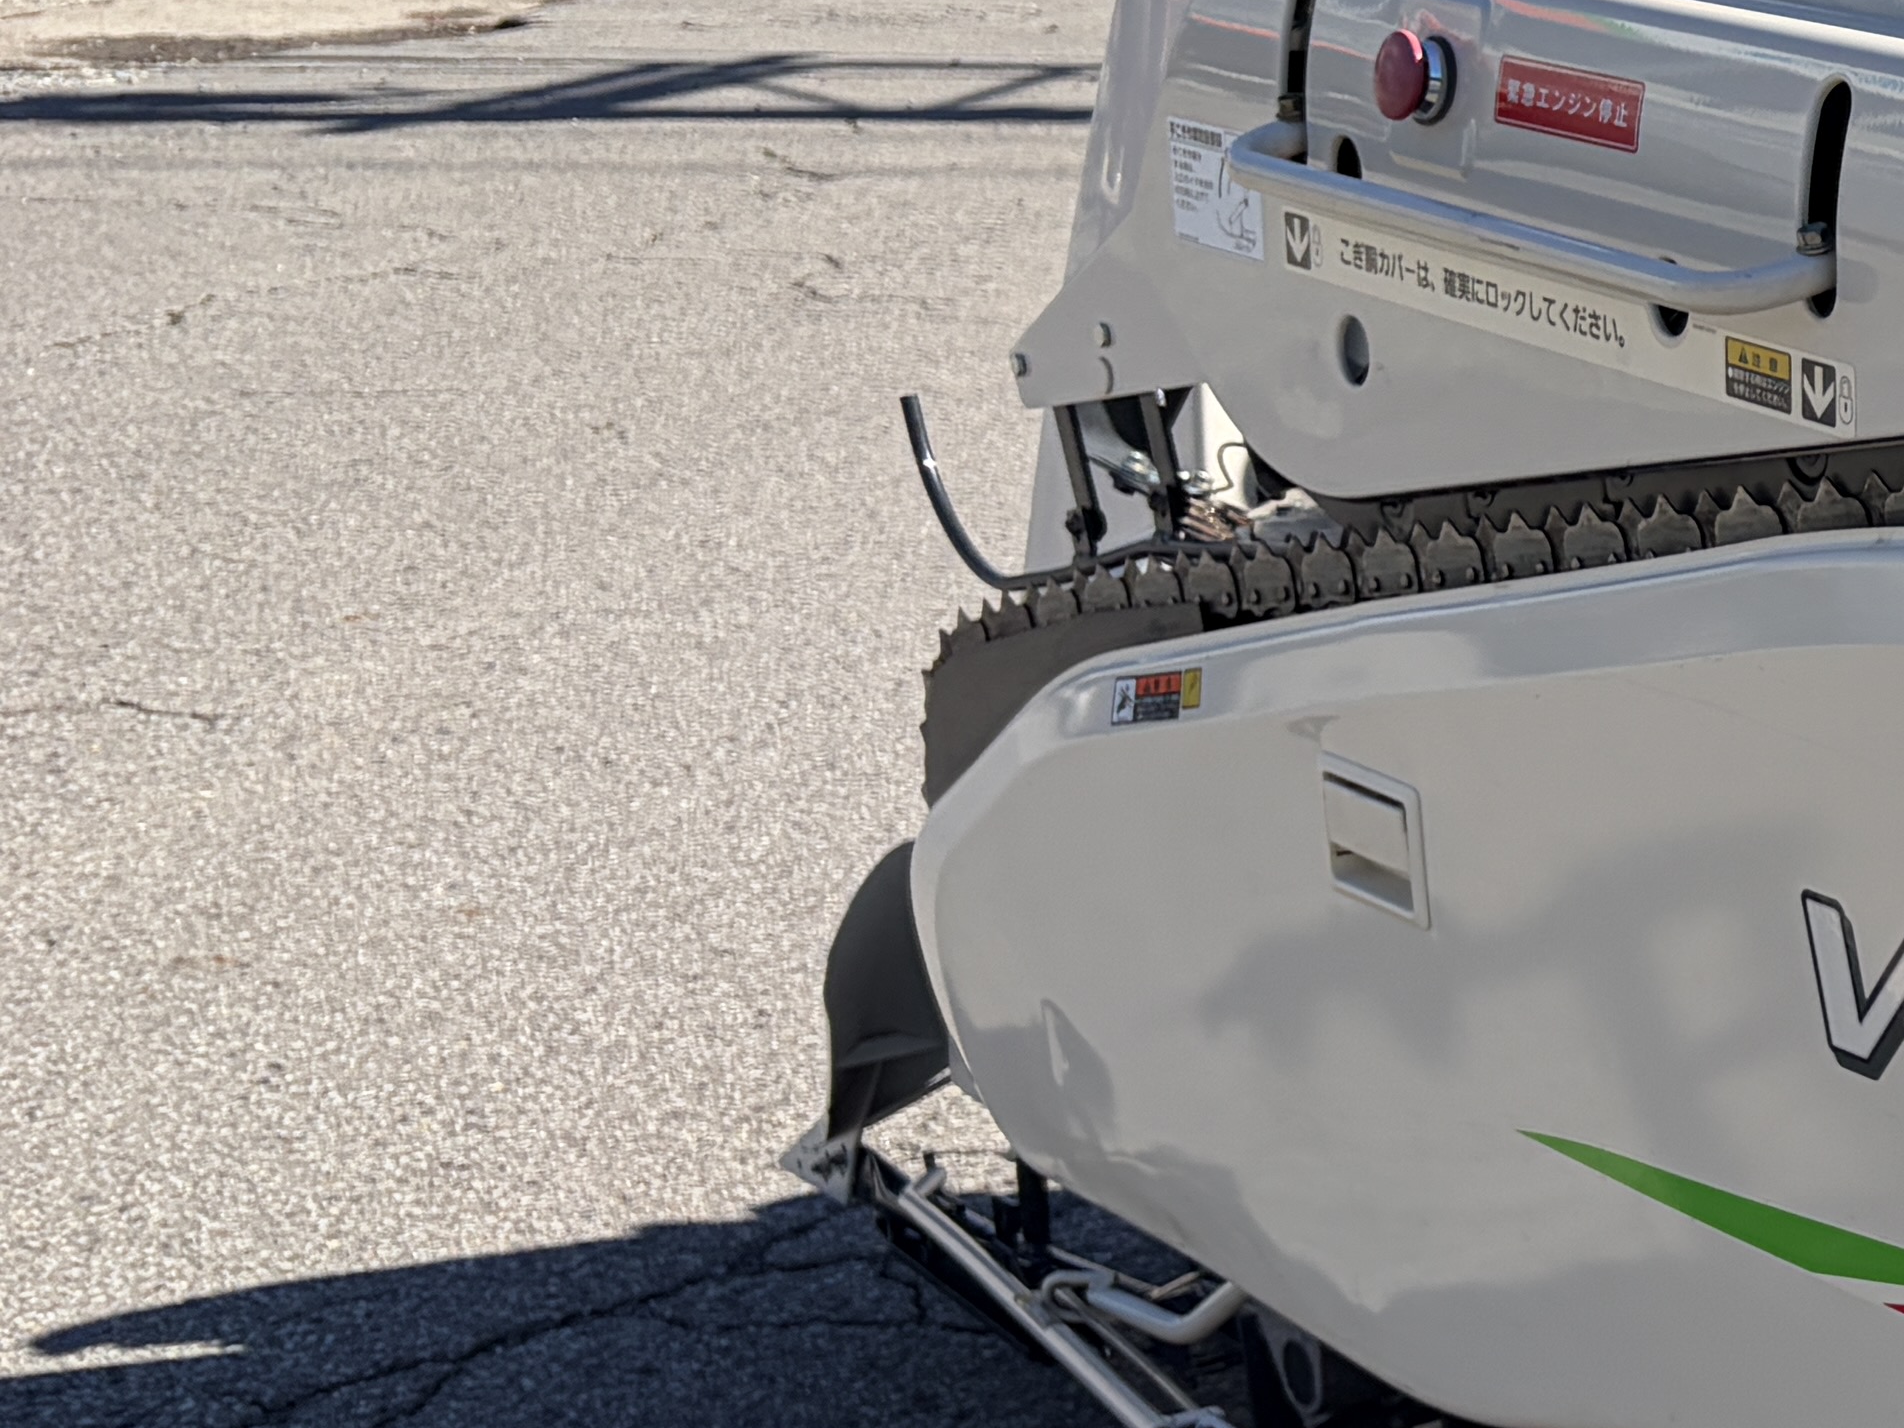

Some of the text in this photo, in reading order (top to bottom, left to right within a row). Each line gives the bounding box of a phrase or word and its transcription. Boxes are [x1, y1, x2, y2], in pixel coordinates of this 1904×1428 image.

[1507, 78, 1628, 128] 緊急エンジン停止
[1340, 238, 1625, 348] こぎ胴カバーは、確実にロックしてください。
